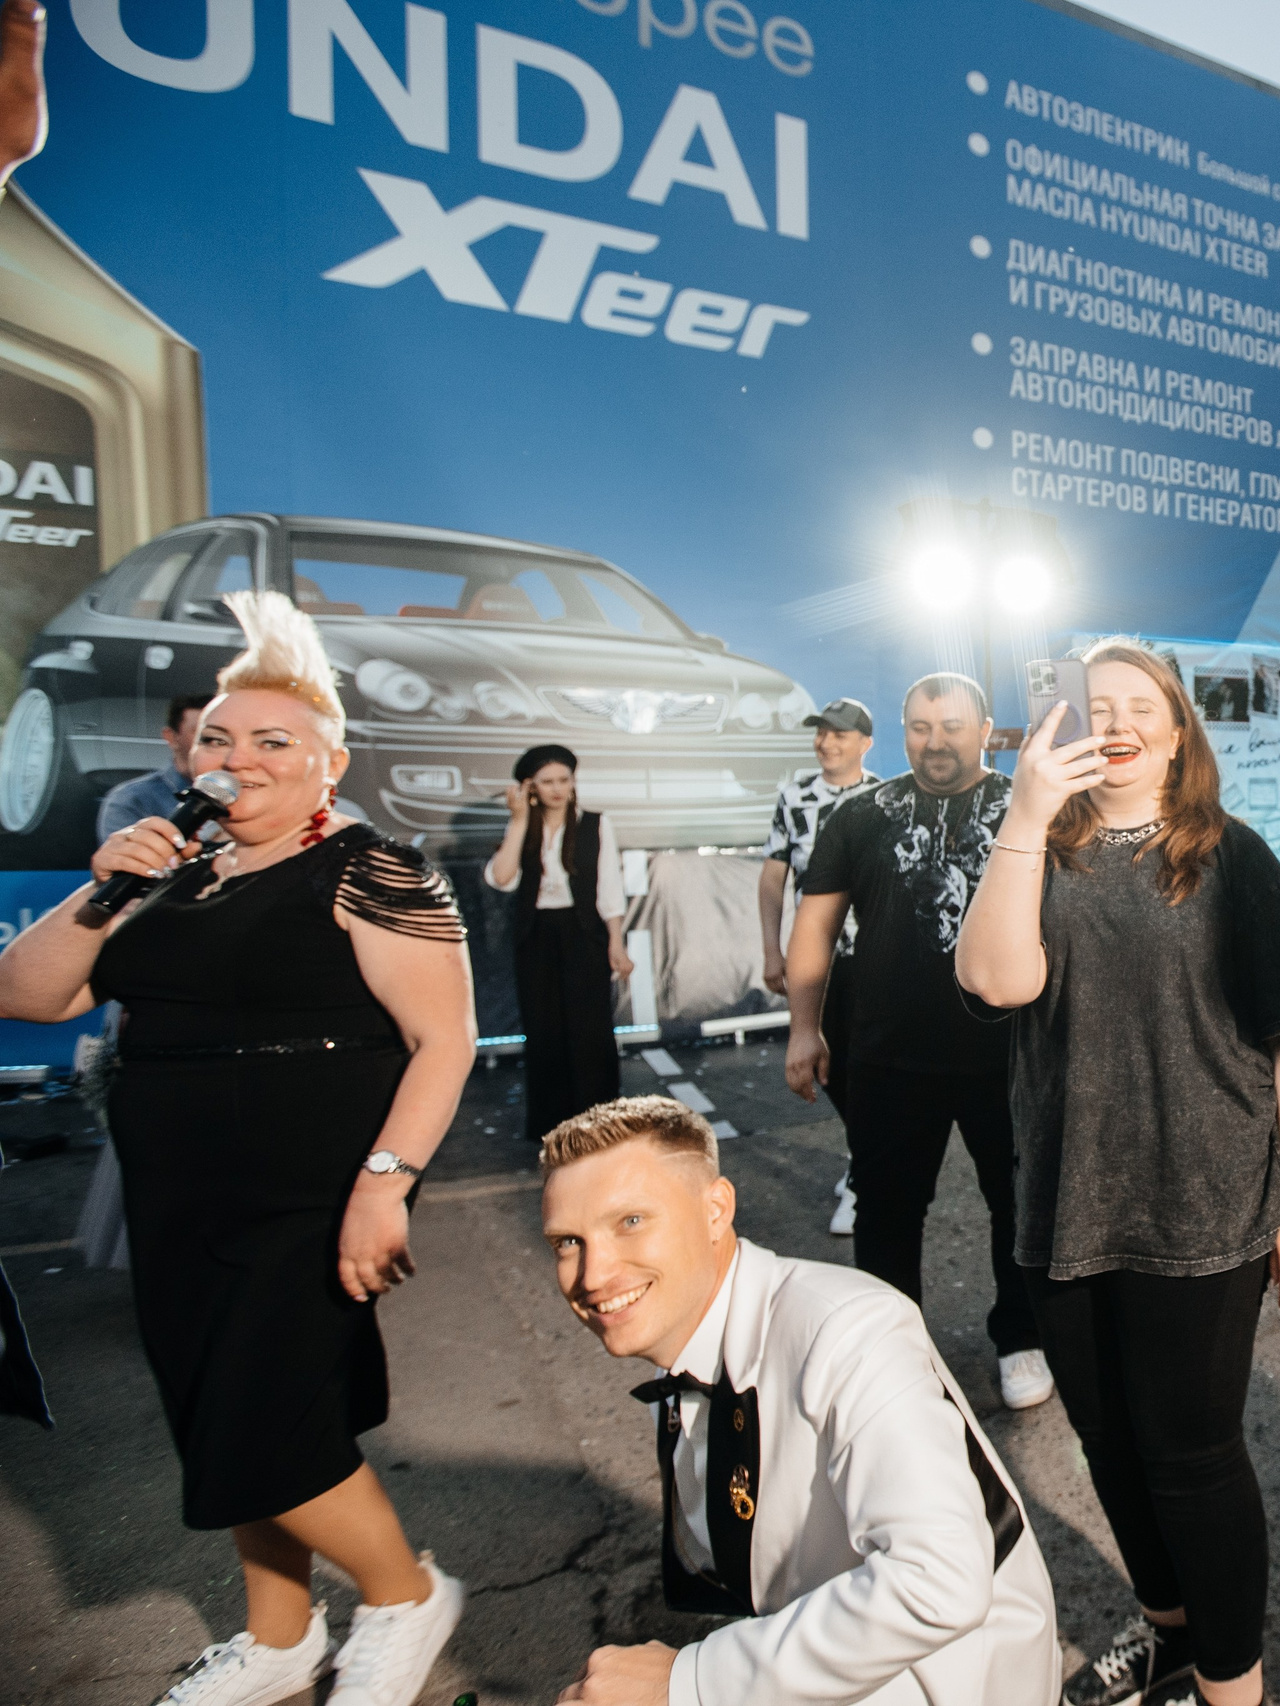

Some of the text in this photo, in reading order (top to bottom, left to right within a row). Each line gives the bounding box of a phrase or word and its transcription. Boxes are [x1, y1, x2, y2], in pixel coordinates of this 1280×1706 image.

[1005, 138, 1189, 222] ОФИЦИАЛЬНАЯ
[1192, 197, 1261, 246] ТОЧКА
[1006, 174, 1269, 279] МАСЛА HYUNDAI XTEER
[321, 167, 811, 359] XTeer
[1006, 238, 1184, 311] ДИАГНОСТИКА
[1187, 286, 1204, 317] И
[1009, 275, 1029, 308] И
[1034, 281, 1163, 339] ГРУЗОВЫХ
[1009, 336, 1254, 415] ЗАПРАВКА И РЕМОНТ
[1009, 369, 1273, 448] АВТОКОНДИЦИОНЕРОВ
[1011, 429, 1116, 474] РЕМОНТ
[1120, 448, 1246, 500] ПОДВЕСКИ,
[1011, 467, 1148, 514] СТАРТЕРОВ
[1152, 487, 1170, 517] И
